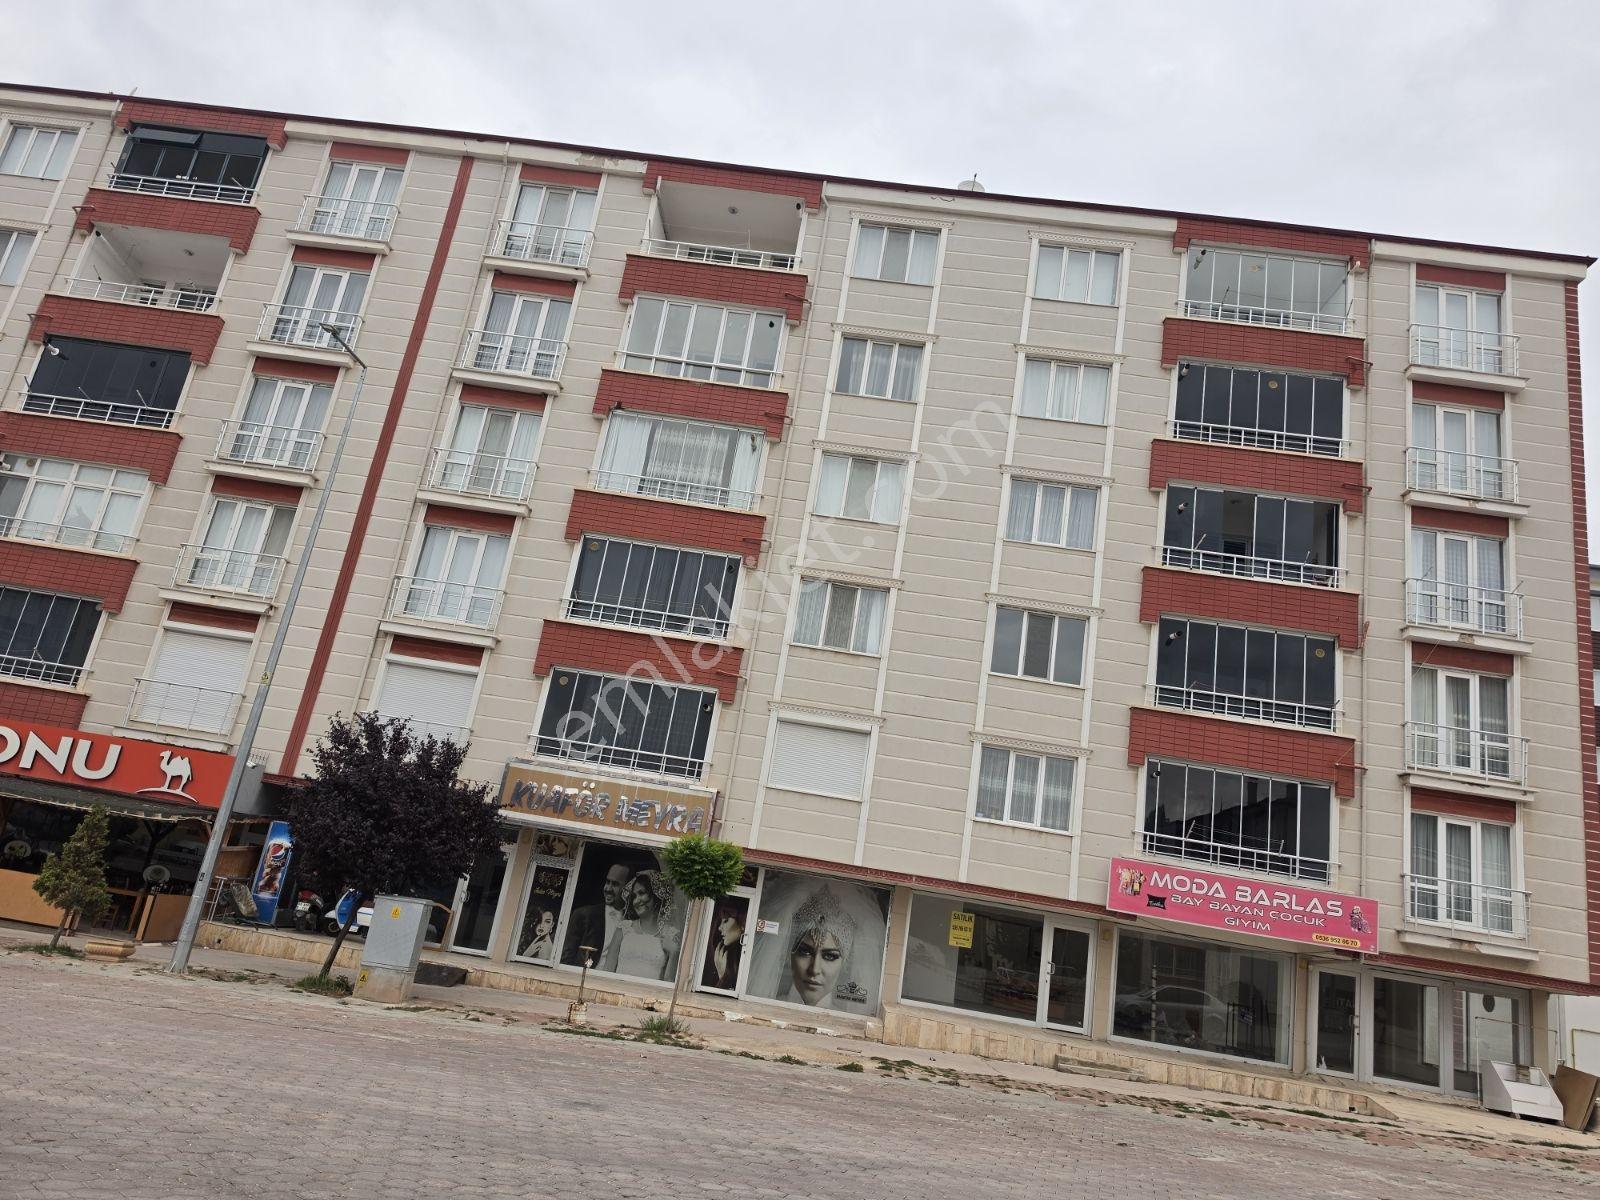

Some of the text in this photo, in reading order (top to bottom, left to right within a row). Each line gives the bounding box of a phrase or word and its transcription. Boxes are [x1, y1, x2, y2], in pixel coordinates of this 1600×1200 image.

[510, 779, 704, 833] KUAFÖR MEYRA
[1149, 871, 1343, 917] MODA BARLAS
[1171, 894, 1203, 907] BAY
[1209, 901, 1264, 917] BAYAN
[1269, 910, 1325, 927] ÇOCUK
